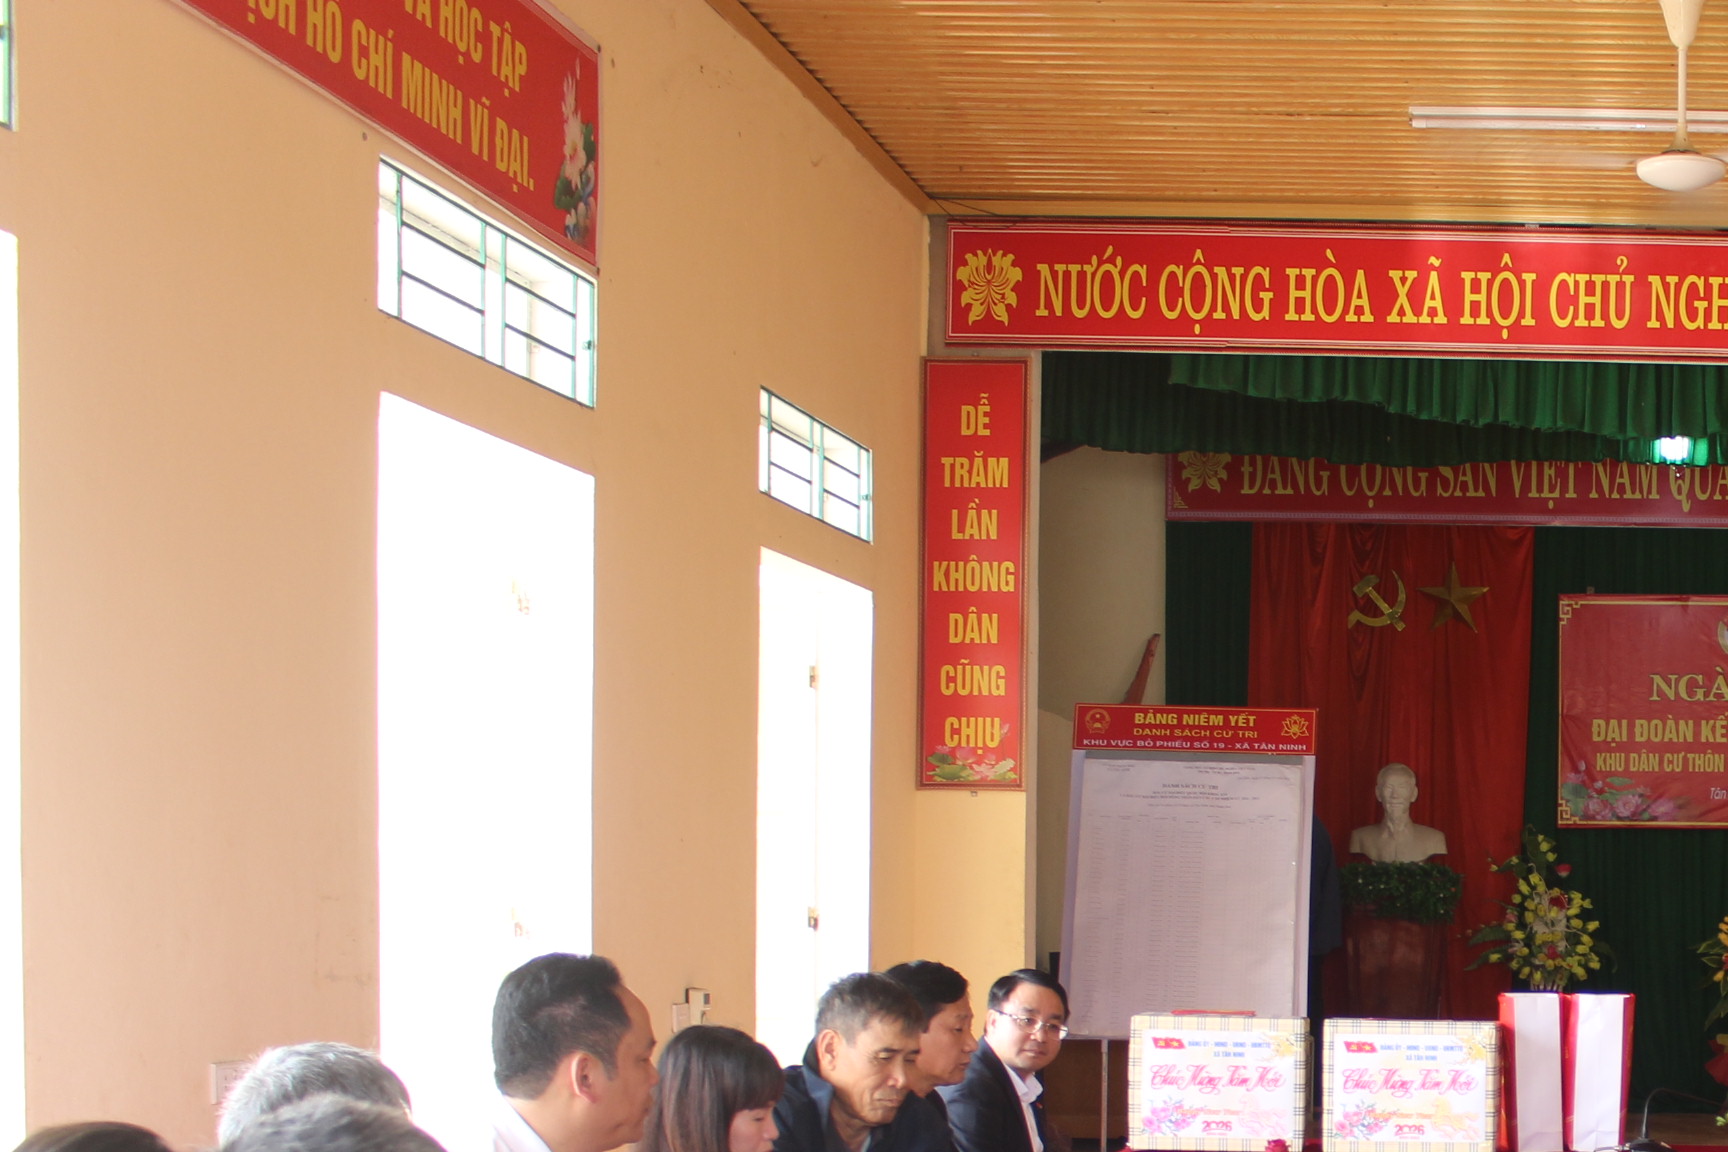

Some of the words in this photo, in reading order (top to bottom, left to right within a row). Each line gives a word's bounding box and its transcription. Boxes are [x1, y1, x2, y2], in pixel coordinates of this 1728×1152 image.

[439, 0, 483, 64] HỌC
[489, 21, 527, 97] TẬP
[352, 19, 393, 98] CHÍ
[402, 51, 462, 145] MINH
[469, 96, 490, 161] VĨ
[495, 117, 534, 192] ĐẠI.
[1036, 246, 1147, 319] NƯỚC
[1159, 249, 1274, 334] CỘNG
[1285, 249, 1374, 323] HÒA
[1386, 256, 1448, 324] XÃ
[1459, 253, 1537, 339] HỘI
[1549, 256, 1635, 329] CHỦ
[961, 393, 991, 435] DỄ
[941, 450, 1009, 488] TRĂM
[1589, 458, 1660, 499] NAM
[951, 498, 998, 540] LẦN
[933, 555, 1015, 592] KHÔNG
[949, 608, 998, 644] DÂN
[940, 659, 1006, 696] CŨNG
[944, 716, 1001, 755] CHỊU
[1133, 727, 1171, 737] DANH
[1174, 726, 1211, 738] SÁCH
[1237, 730, 1258, 739] TRI
[1135, 710, 1178, 725] BẢNG
[1182, 712, 1224, 727] NIÊM
[1229, 712, 1257, 727] YẾT
[1592, 718, 1627, 747] ĐẠI
[1634, 715, 1694, 743] ĐOÀN
[1083, 738, 1107, 746] KHU
[1109, 738, 1134, 748] VỰC
[1156, 738, 1191, 749] PHIẾU
[1193, 738, 1210, 749] SỐ
[1234, 740, 1251, 750] XÃ
[1253, 741, 1276, 750] TÂN
[1279, 743, 1307, 751] NINH
[1596, 753, 1628, 772] KHU
[1629, 749, 1659, 772] DÂN
[1663, 751, 1685, 772] CƯ
[1687, 749, 1724, 773] THÔN
